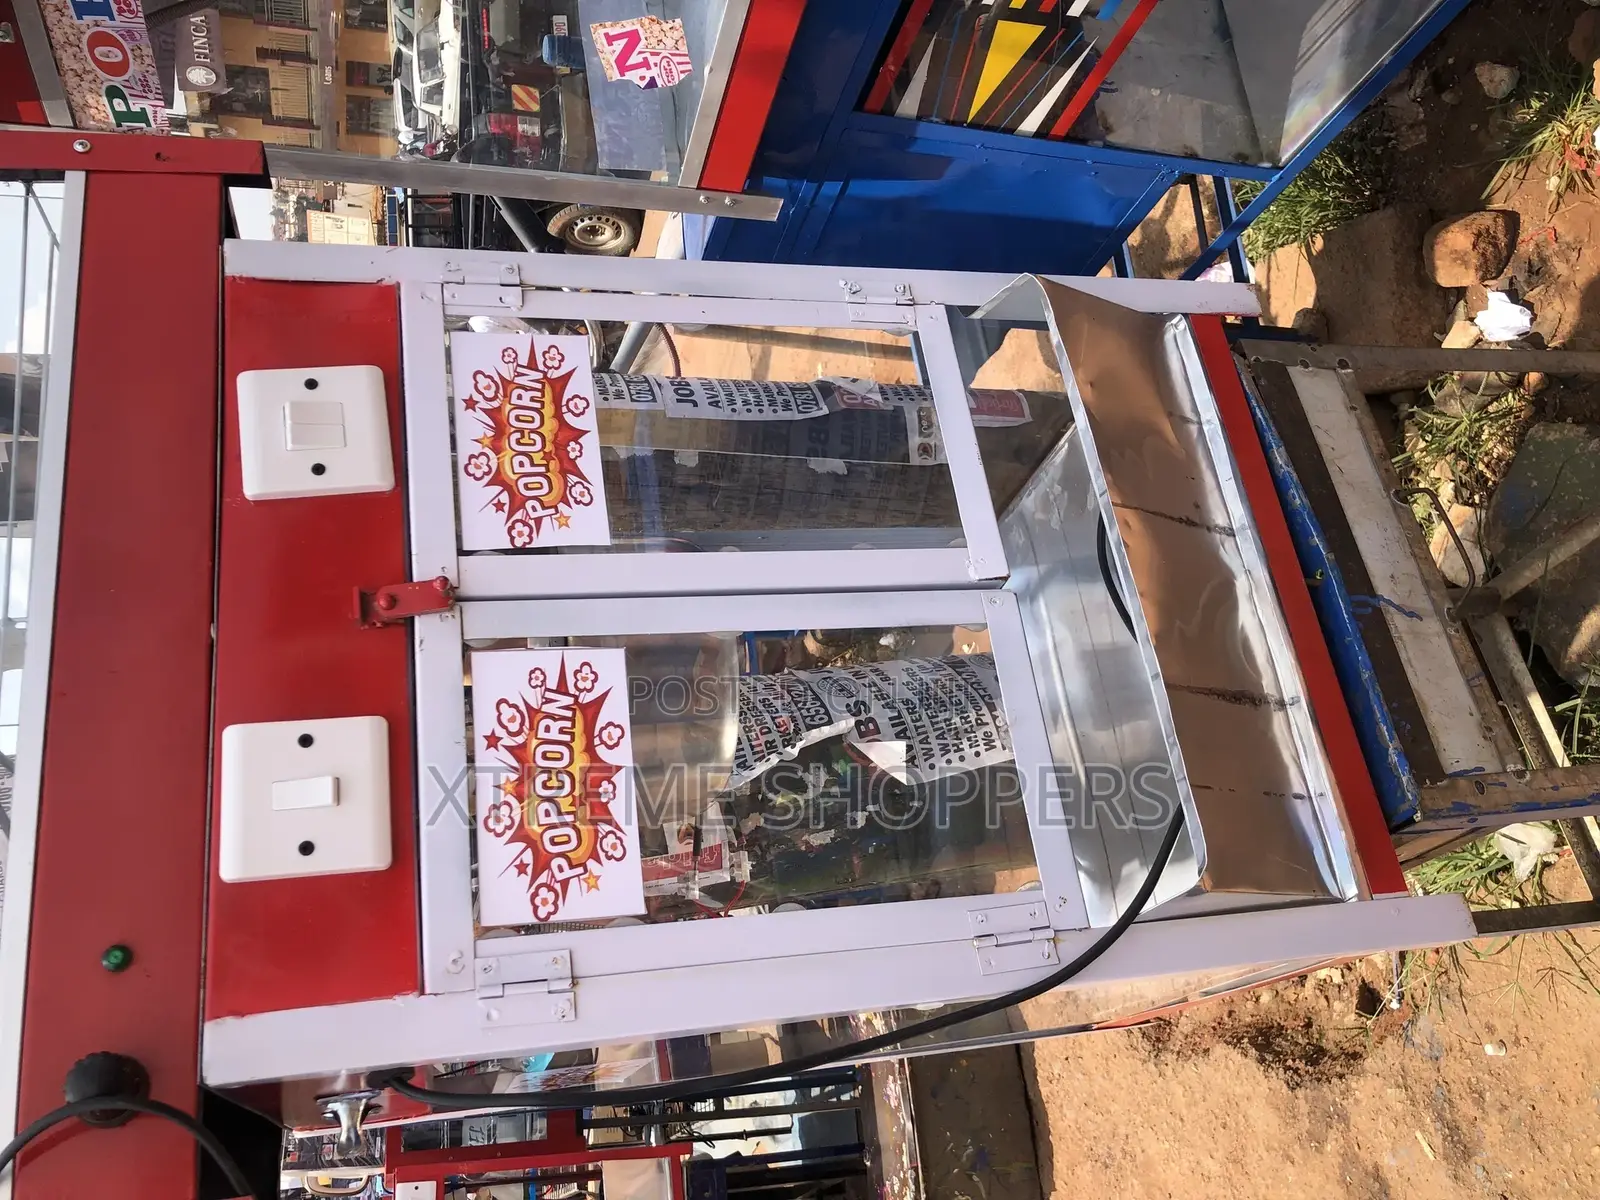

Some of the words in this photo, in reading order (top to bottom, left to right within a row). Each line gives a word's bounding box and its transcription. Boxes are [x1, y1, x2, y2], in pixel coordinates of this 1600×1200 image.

[189, 15, 211, 63] FINCA
[603, 28, 652, 77] N
[322, 65, 333, 85] Loans
[631, 383, 655, 402] 0781
[746, 385, 764, 407] HAIR
[782, 398, 794, 413] We
[793, 389, 820, 412] 0781
[511, 364, 557, 519] POPCORN
[897, 697, 935, 763] WAITERS
[942, 717, 966, 754] HAIR
[981, 730, 998, 753] We
[535, 689, 588, 880] POPCORN
